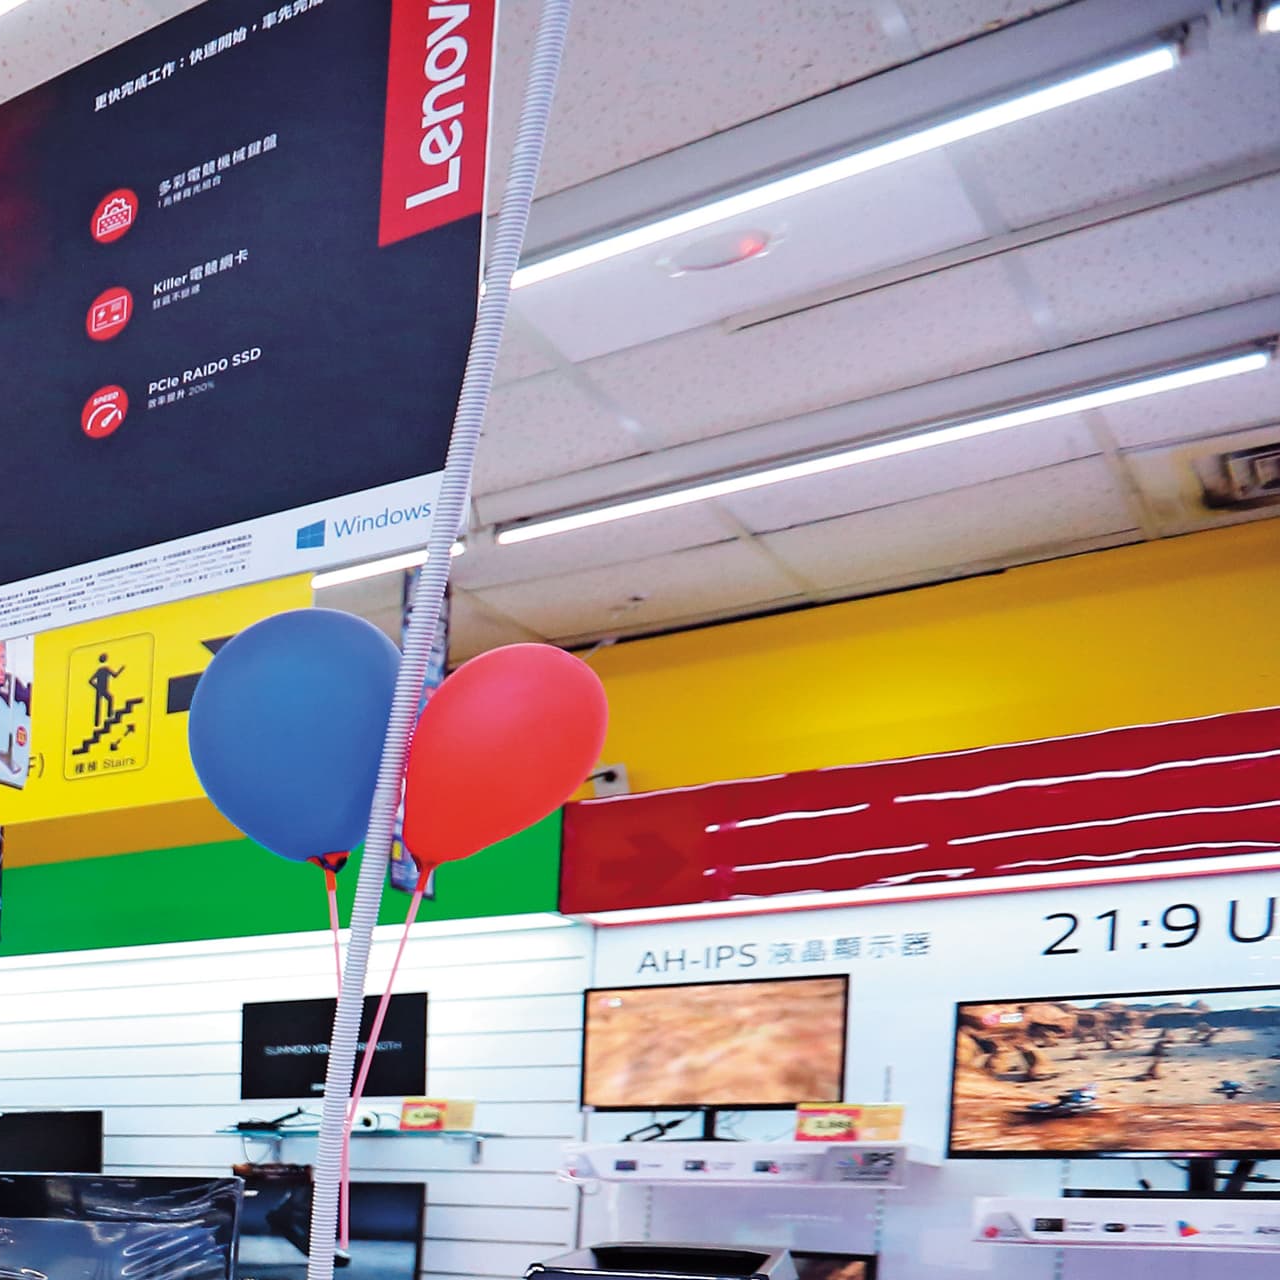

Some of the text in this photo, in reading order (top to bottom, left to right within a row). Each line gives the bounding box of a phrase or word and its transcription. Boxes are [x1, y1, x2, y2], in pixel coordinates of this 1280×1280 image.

[406, 0, 470, 209] Lenov
[153, 274, 188, 296] Killer
[148, 376, 179, 395] PCIe
[232, 348, 262, 367] SSD
[333, 502, 432, 540] Windows
[102, 755, 136, 771] Stairs
[1042, 903, 1201, 957] 21:9
[638, 931, 933, 974] AH-IPS 液晶顯示器
[264, 1044, 312, 1057] SUMMON
